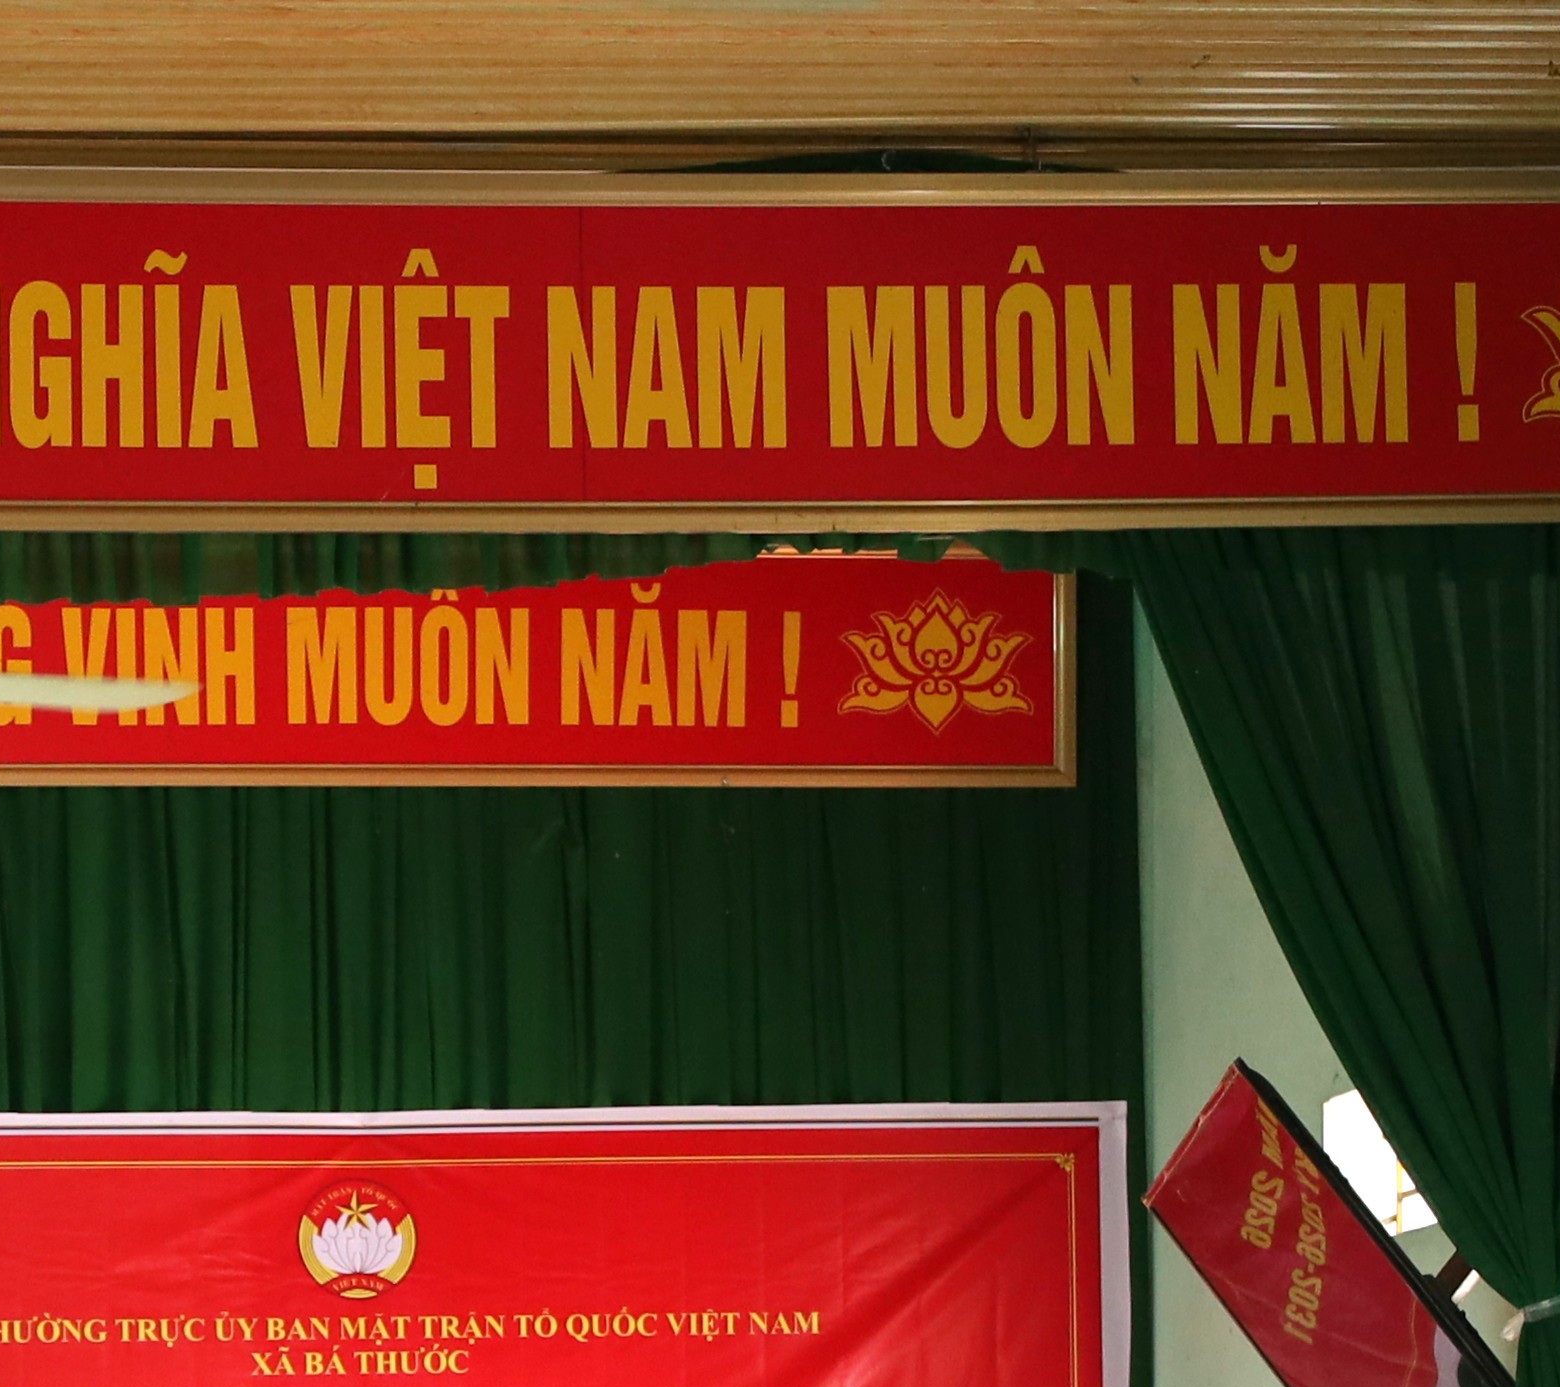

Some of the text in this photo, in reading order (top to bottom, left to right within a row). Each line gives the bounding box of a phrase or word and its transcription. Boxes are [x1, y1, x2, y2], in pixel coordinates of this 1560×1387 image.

[290, 248, 510, 490] VIỆT
[547, 286, 787, 448] NAM
[827, 245, 1135, 449] MUÔN
[1173, 244, 1408, 444] NĂM
[1456, 282, 1480, 442] !
[60, 604, 255, 726] VINH
[288, 588, 529, 727] MUÔN
[563, 586, 746, 727] NĂM
[783, 613, 801, 726] !
[115, 1315, 205, 1349] TRỰC
[215, 1310, 257, 1343] ỦY
[267, 1316, 329, 1341] BAN
[341, 1316, 411, 1351] MẶT
[418, 1314, 504, 1348] TRẬN
[513, 1305, 558, 1339] TỔ
[566, 1306, 657, 1342] QUỐC
[667, 1311, 740, 1343] VIỆT
[750, 1310, 819, 1335] NAM
[252, 1343, 471, 1377] XÃ BÁ THƯỚC
